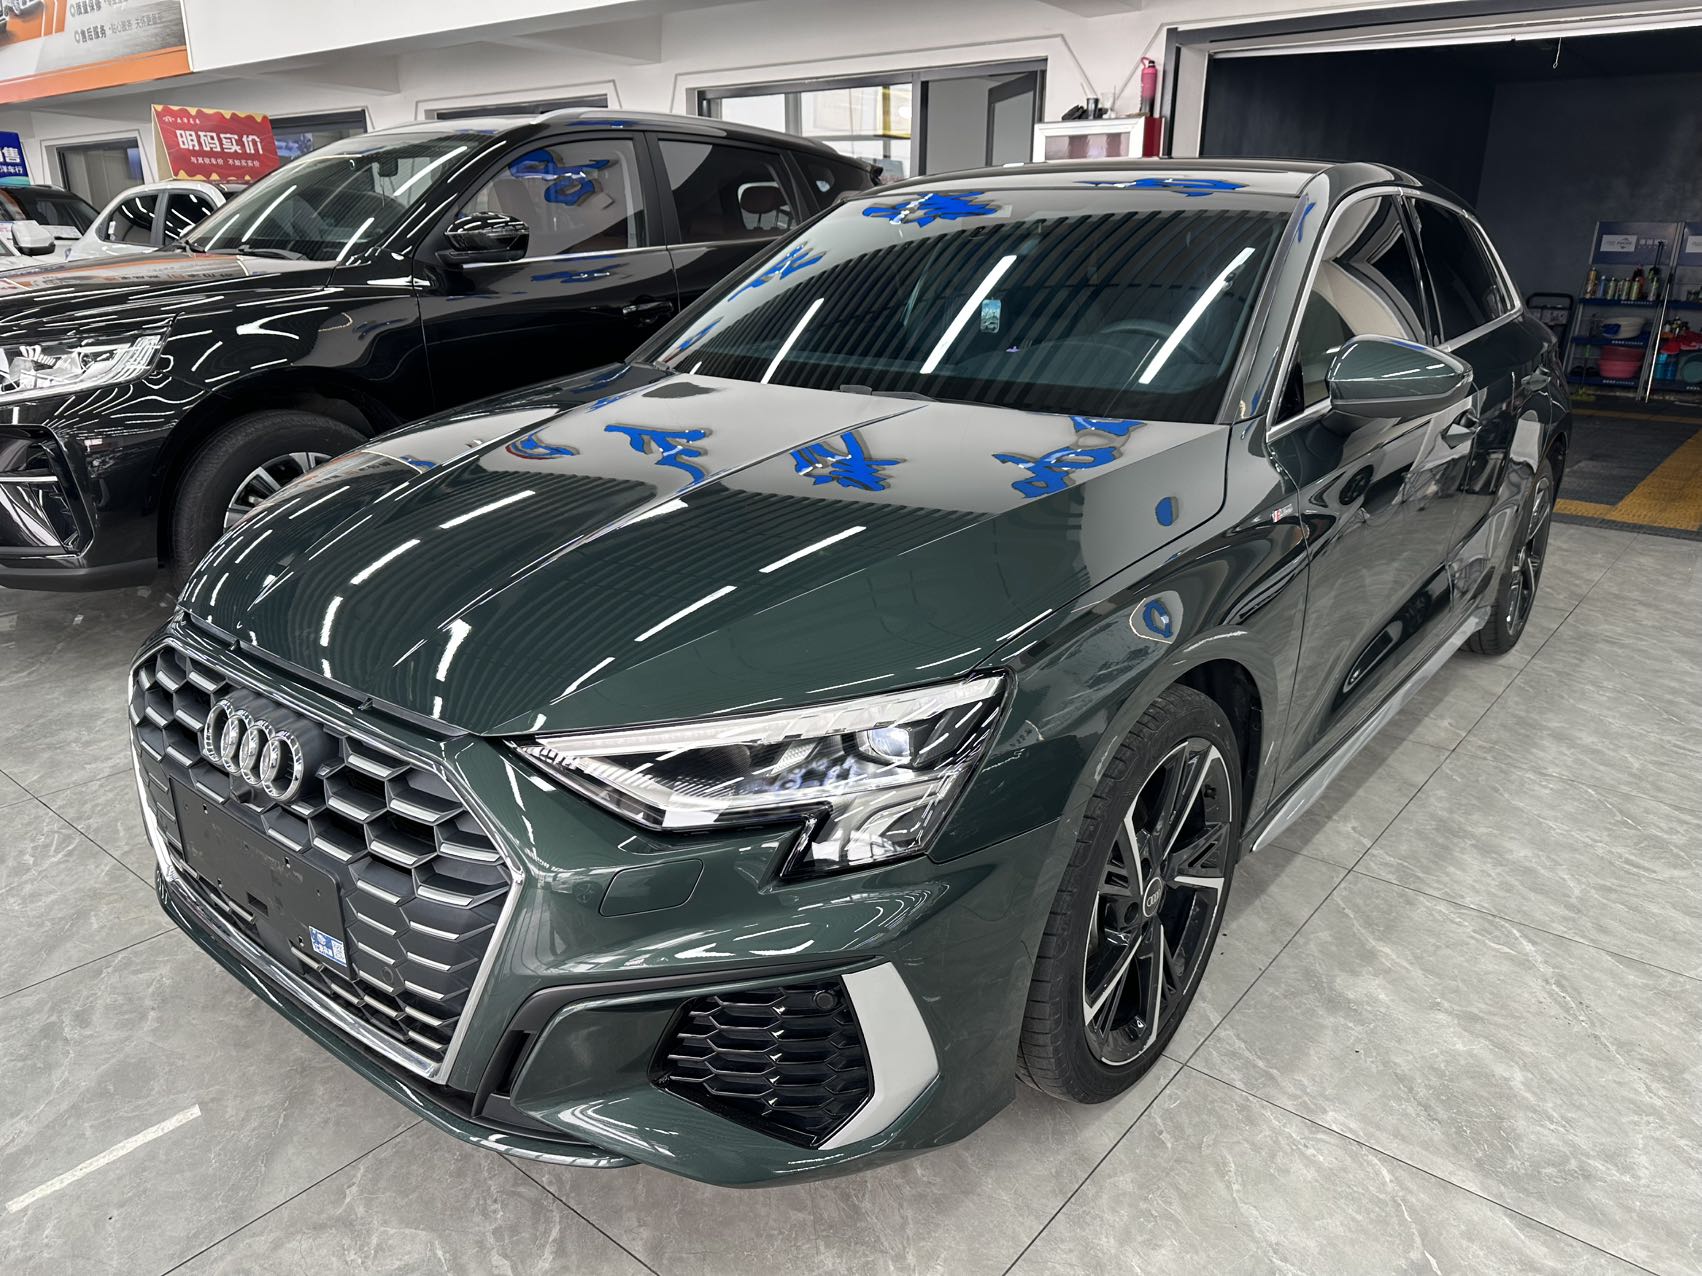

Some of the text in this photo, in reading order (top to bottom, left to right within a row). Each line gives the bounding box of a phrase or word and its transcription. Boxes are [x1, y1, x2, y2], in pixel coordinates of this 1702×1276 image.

[80, 25, 107, 43] 售后服务
[176, 130, 263, 154] 明码实价
[0, 146, 20, 162] 售
